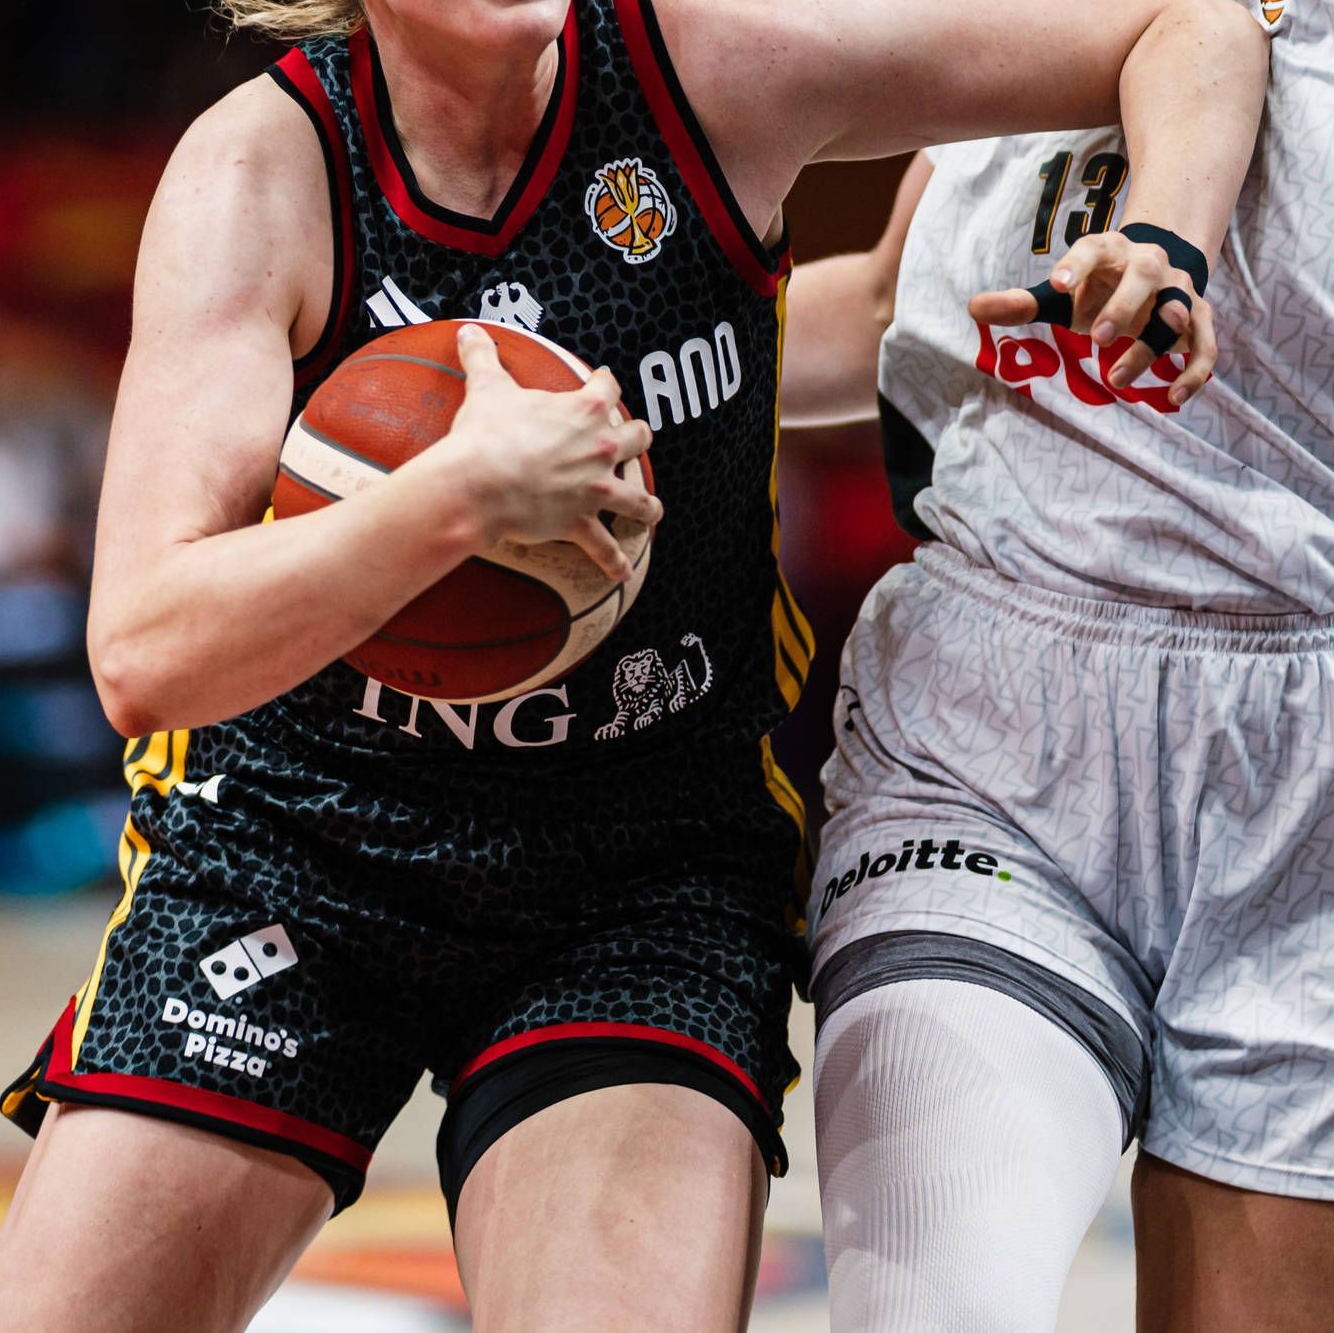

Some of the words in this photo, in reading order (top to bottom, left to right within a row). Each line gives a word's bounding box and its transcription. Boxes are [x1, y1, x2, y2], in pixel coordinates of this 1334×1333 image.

[1031, 150, 1129, 254] 13
[352, 676, 577, 750] ING
[161, 997, 299, 1059] Domino's
[183, 1032, 267, 1078] Pizza
